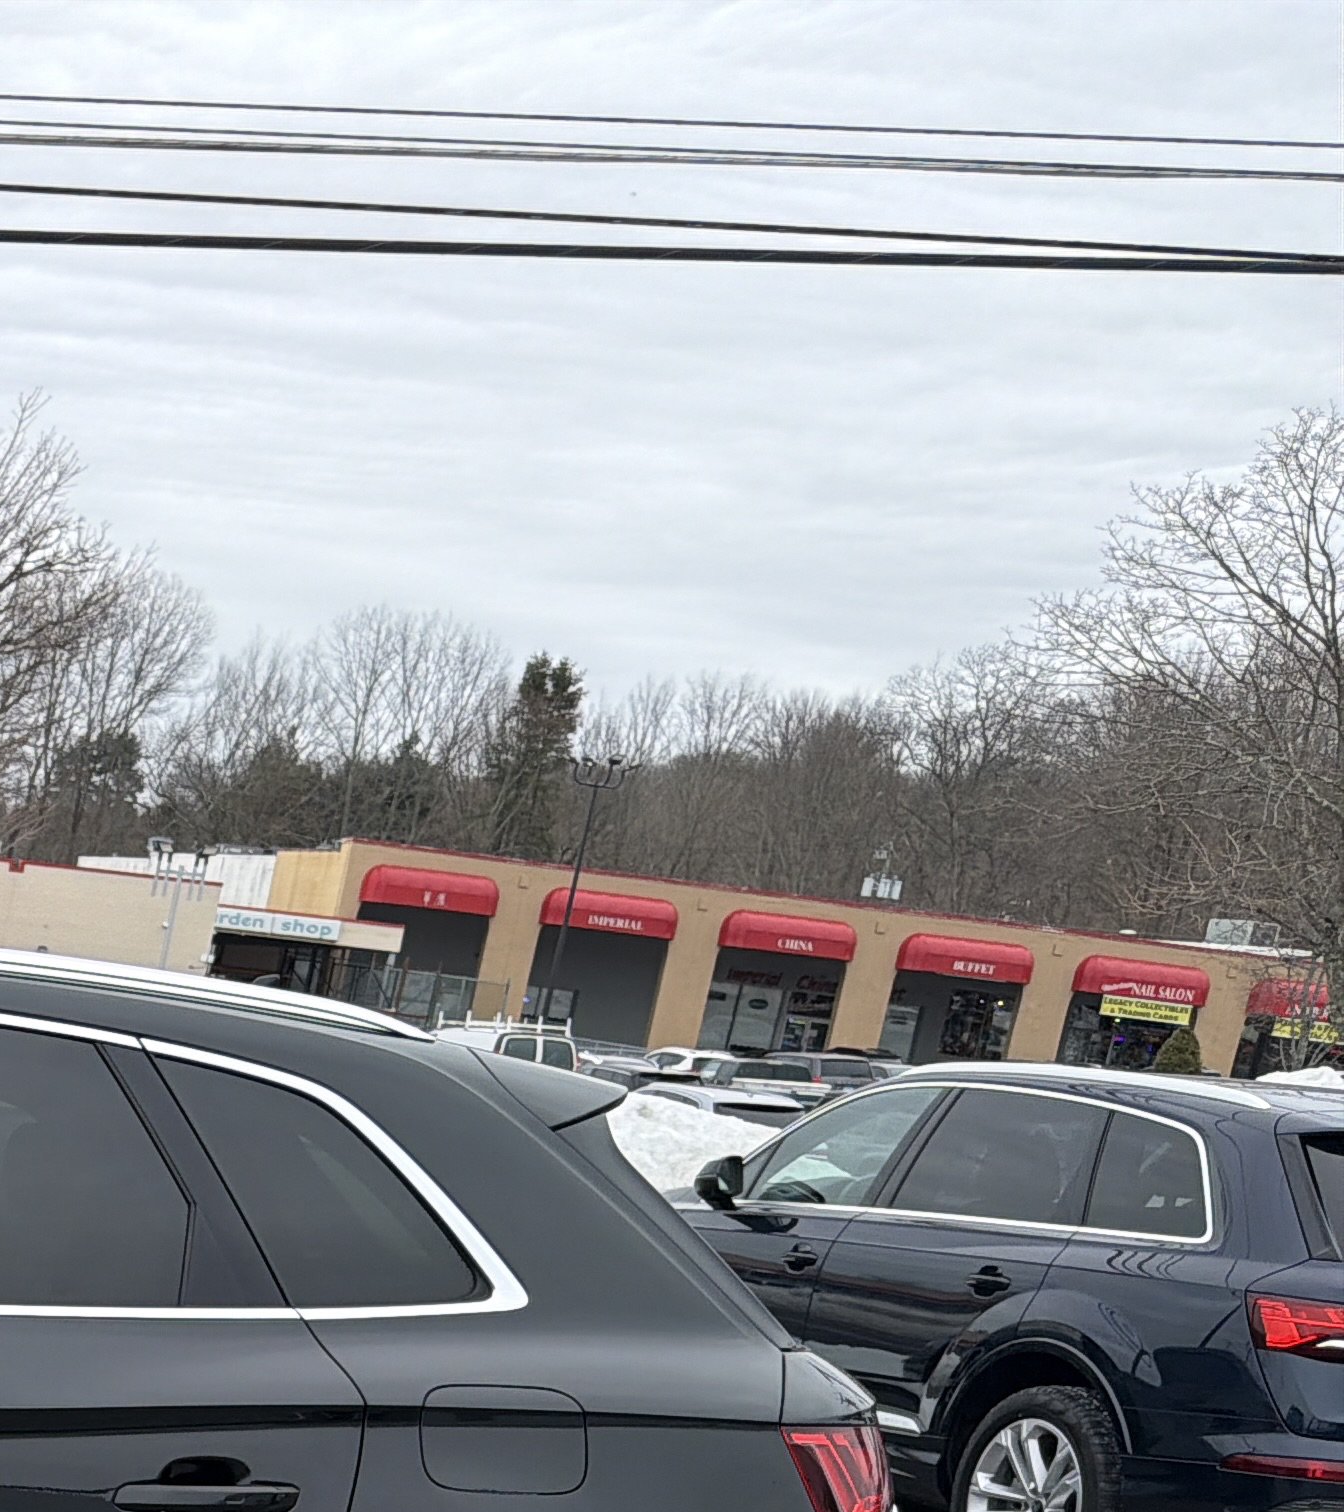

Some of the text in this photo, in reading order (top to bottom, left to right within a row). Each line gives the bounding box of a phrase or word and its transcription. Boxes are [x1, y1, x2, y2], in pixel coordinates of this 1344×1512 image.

[216, 912, 333, 939] rden shop
[587, 914, 643, 931] IMPERIAL
[777, 938, 814, 952] CHINA
[952, 960, 996, 975] BUFFET
[1130, 983, 1196, 1002] NAIL SALON
